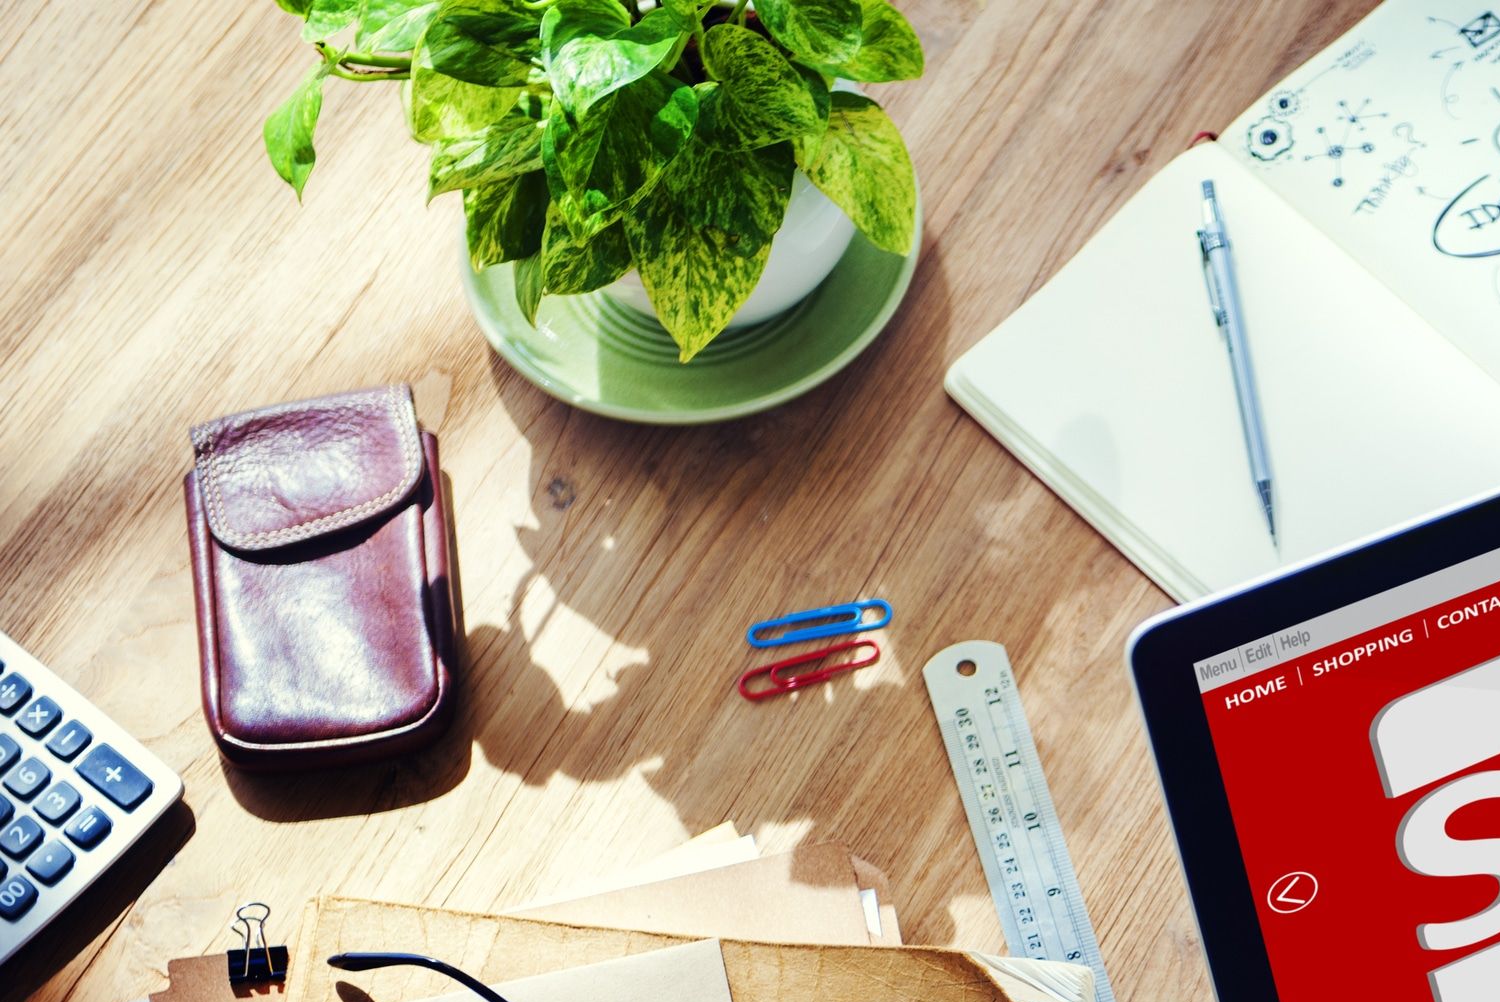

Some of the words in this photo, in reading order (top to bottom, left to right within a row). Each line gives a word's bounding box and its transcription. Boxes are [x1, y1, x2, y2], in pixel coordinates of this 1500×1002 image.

[1199, 656, 1238, 682] Menu
[1245, 641, 1273, 665] Edit
[1280, 628, 1311, 654] Help
[1221, 673, 1286, 709] HOME
[1311, 627, 1413, 676] SHOPPING
[984, 687, 1002, 706] 12
[1004, 750, 1021, 768] 11
[19, 766, 37, 785] 6
[46, 792, 66, 811] 3
[1023, 812, 1041, 831] 10
[9, 826, 31, 845] 2
[1004, 857, 1018, 874] 24
[1011, 882, 1026, 900] 23
[1047, 887, 1062, 897] 9
[1018, 907, 1034, 924] 22
[1027, 933, 1042, 950] 21
[1067, 950, 1081, 961] 8
